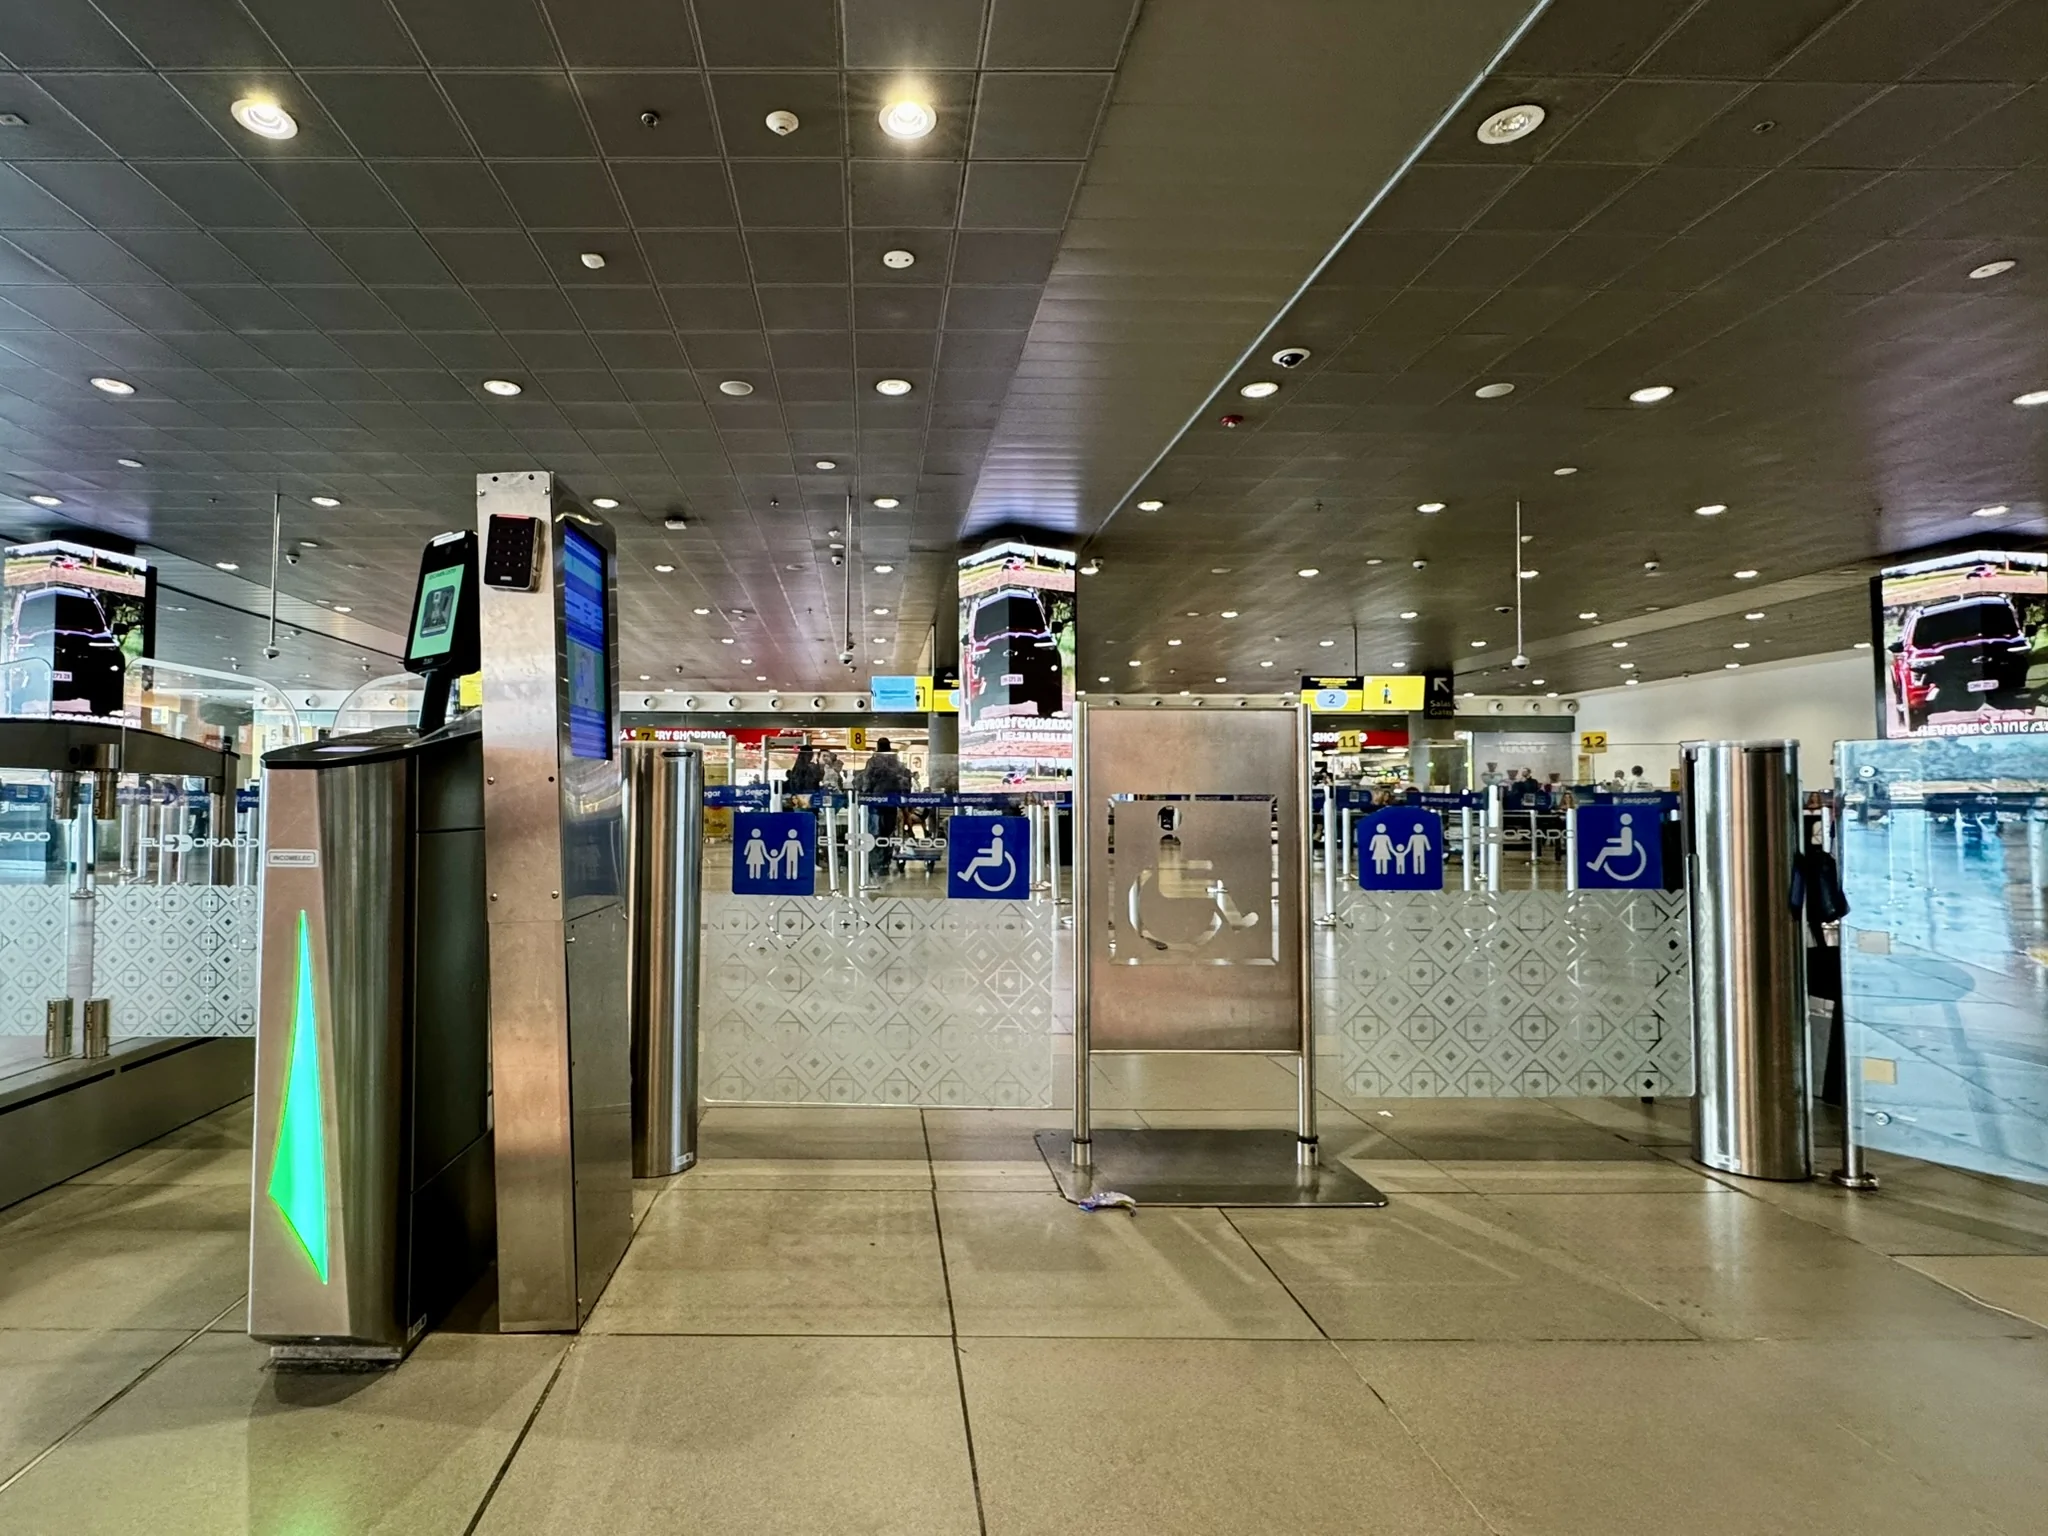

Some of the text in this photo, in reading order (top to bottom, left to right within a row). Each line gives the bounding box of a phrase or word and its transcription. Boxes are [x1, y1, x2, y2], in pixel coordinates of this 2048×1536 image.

[1328, 693, 1336, 704] 2
[854, 733, 862, 745] 8
[1340, 735, 1358, 748] 11
[1583, 736, 1605, 748] 12
